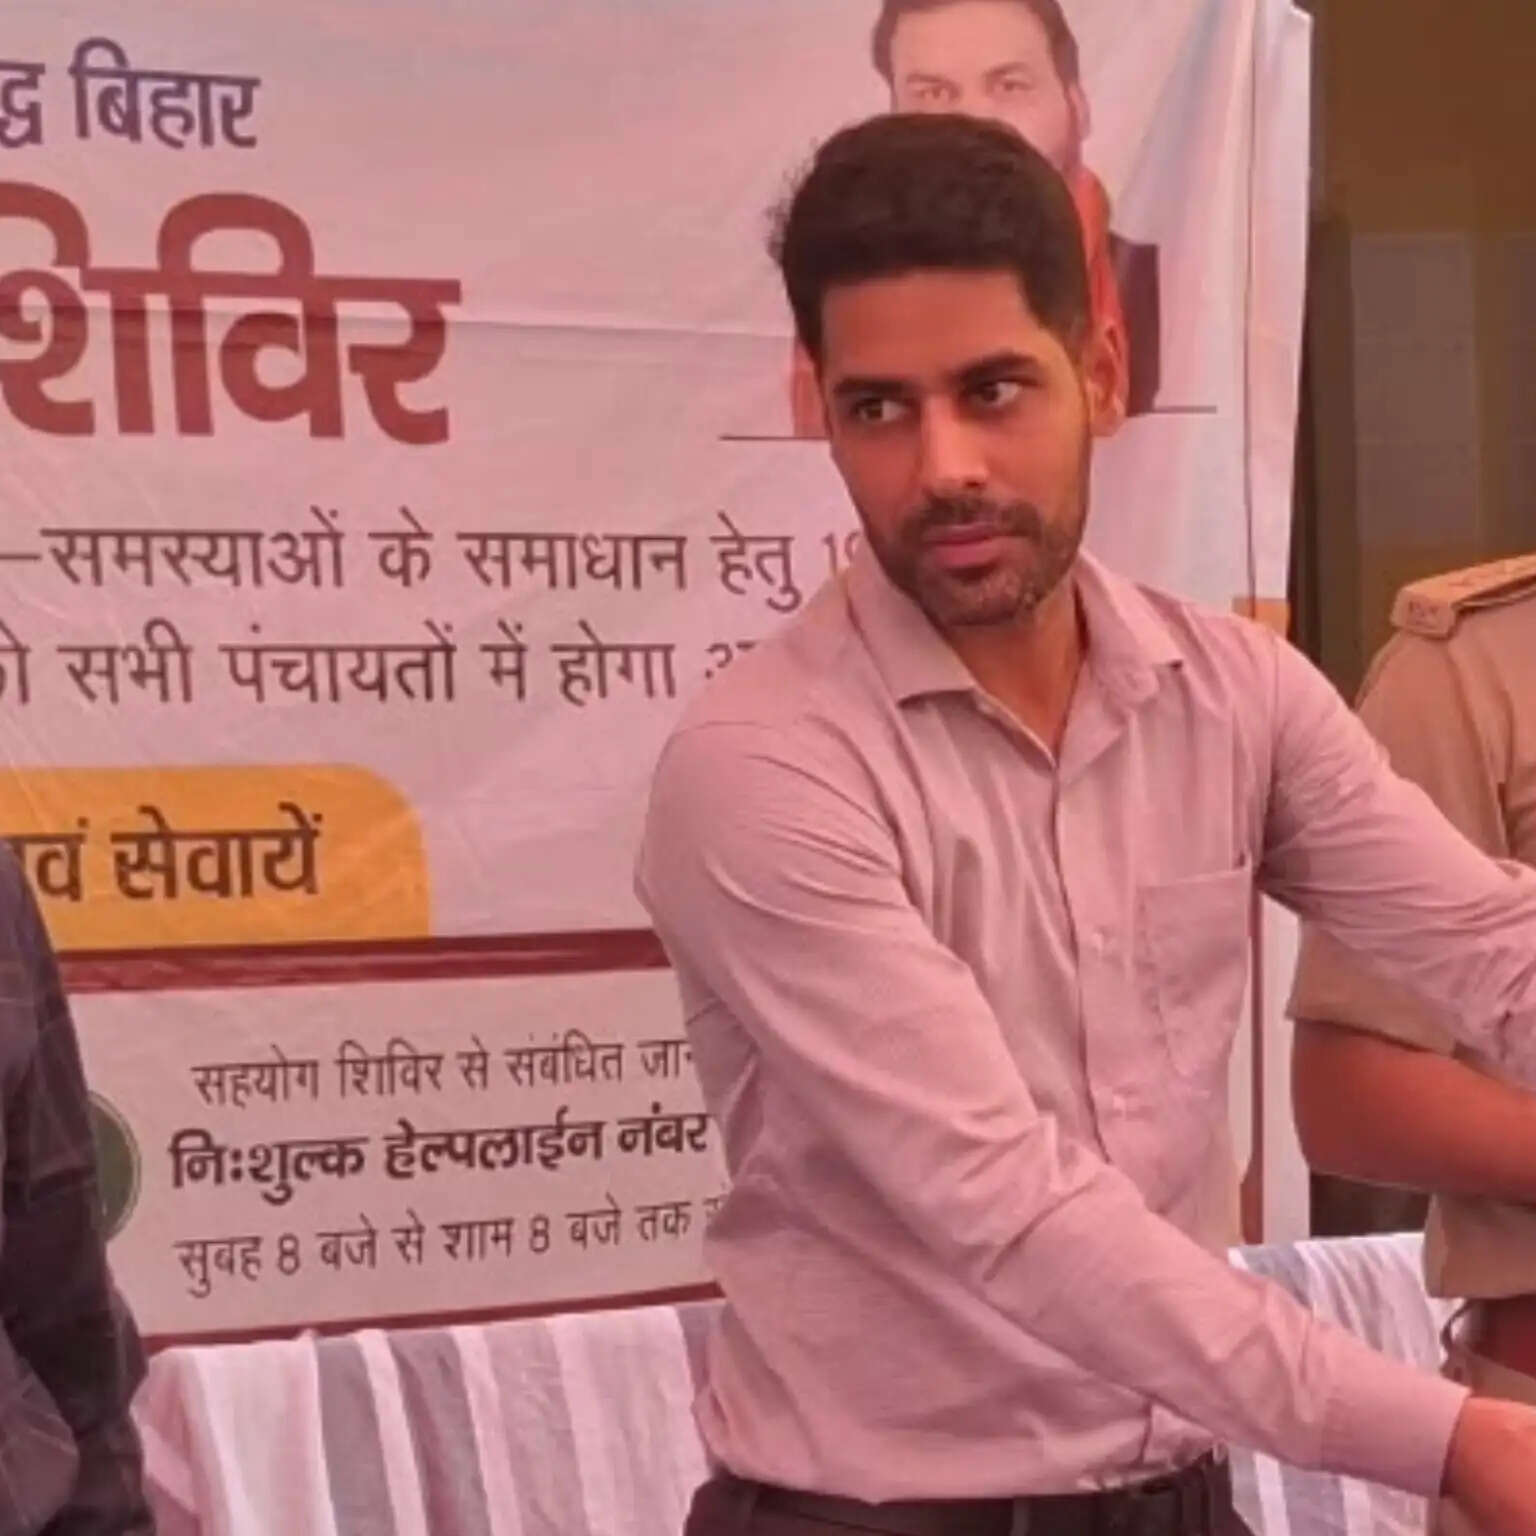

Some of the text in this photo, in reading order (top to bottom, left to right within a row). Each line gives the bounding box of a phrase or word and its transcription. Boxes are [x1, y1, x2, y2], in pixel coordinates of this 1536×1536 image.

[66, 36, 263, 151] बिहार
[374, 505, 435, 589] के
[457, 530, 689, 592] समाधान
[712, 509, 804, 614] हेतु
[60, 618, 194, 705] सभी
[222, 618, 459, 704] पंचायतों
[482, 623, 530, 702] में
[552, 633, 677, 708] होगा
[10, 800, 324, 904] वं सेवायें
[189, 1043, 321, 1110] सहयोग
[332, 1036, 446, 1099] शिविर
[455, 1034, 491, 1091] से
[502, 1027, 626, 1088] संबंधित
[382, 1110, 608, 1181] हेल्पलाईन
[614, 1101, 712, 1161] नंबर
[172, 1234, 265, 1300] सुबह
[275, 1232, 302, 1277] 8
[314, 1213, 380, 1272] बजे
[389, 1208, 427, 1266] से
[437, 1216, 516, 1261] शाम
[528, 1212, 552, 1256] 8
[563, 1190, 624, 1251] बजे
[634, 1199, 694, 1242] तक
